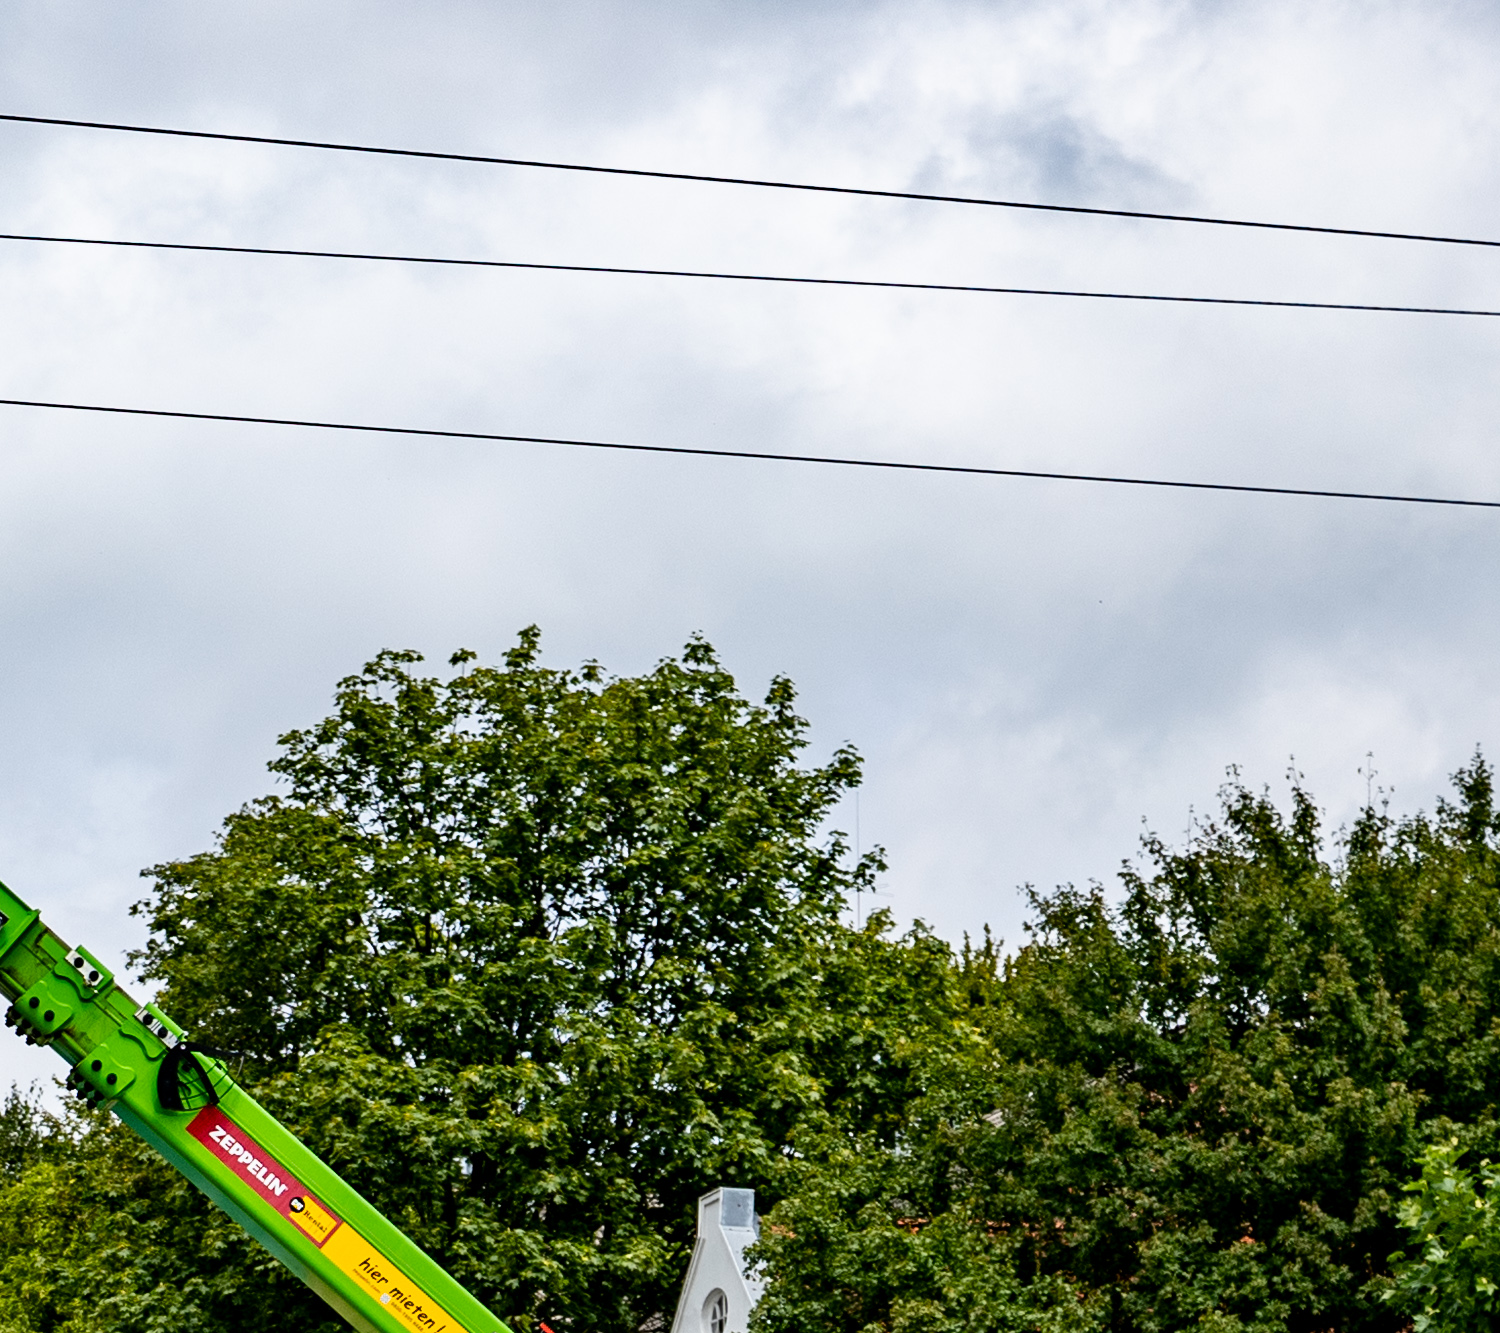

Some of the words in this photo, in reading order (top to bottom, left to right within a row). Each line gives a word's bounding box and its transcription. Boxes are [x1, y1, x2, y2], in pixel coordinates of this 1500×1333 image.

[208, 1124, 288, 1197] ZEPPELIN
[358, 1257, 389, 1284] hier
[389, 1287, 436, 1330] mieten
